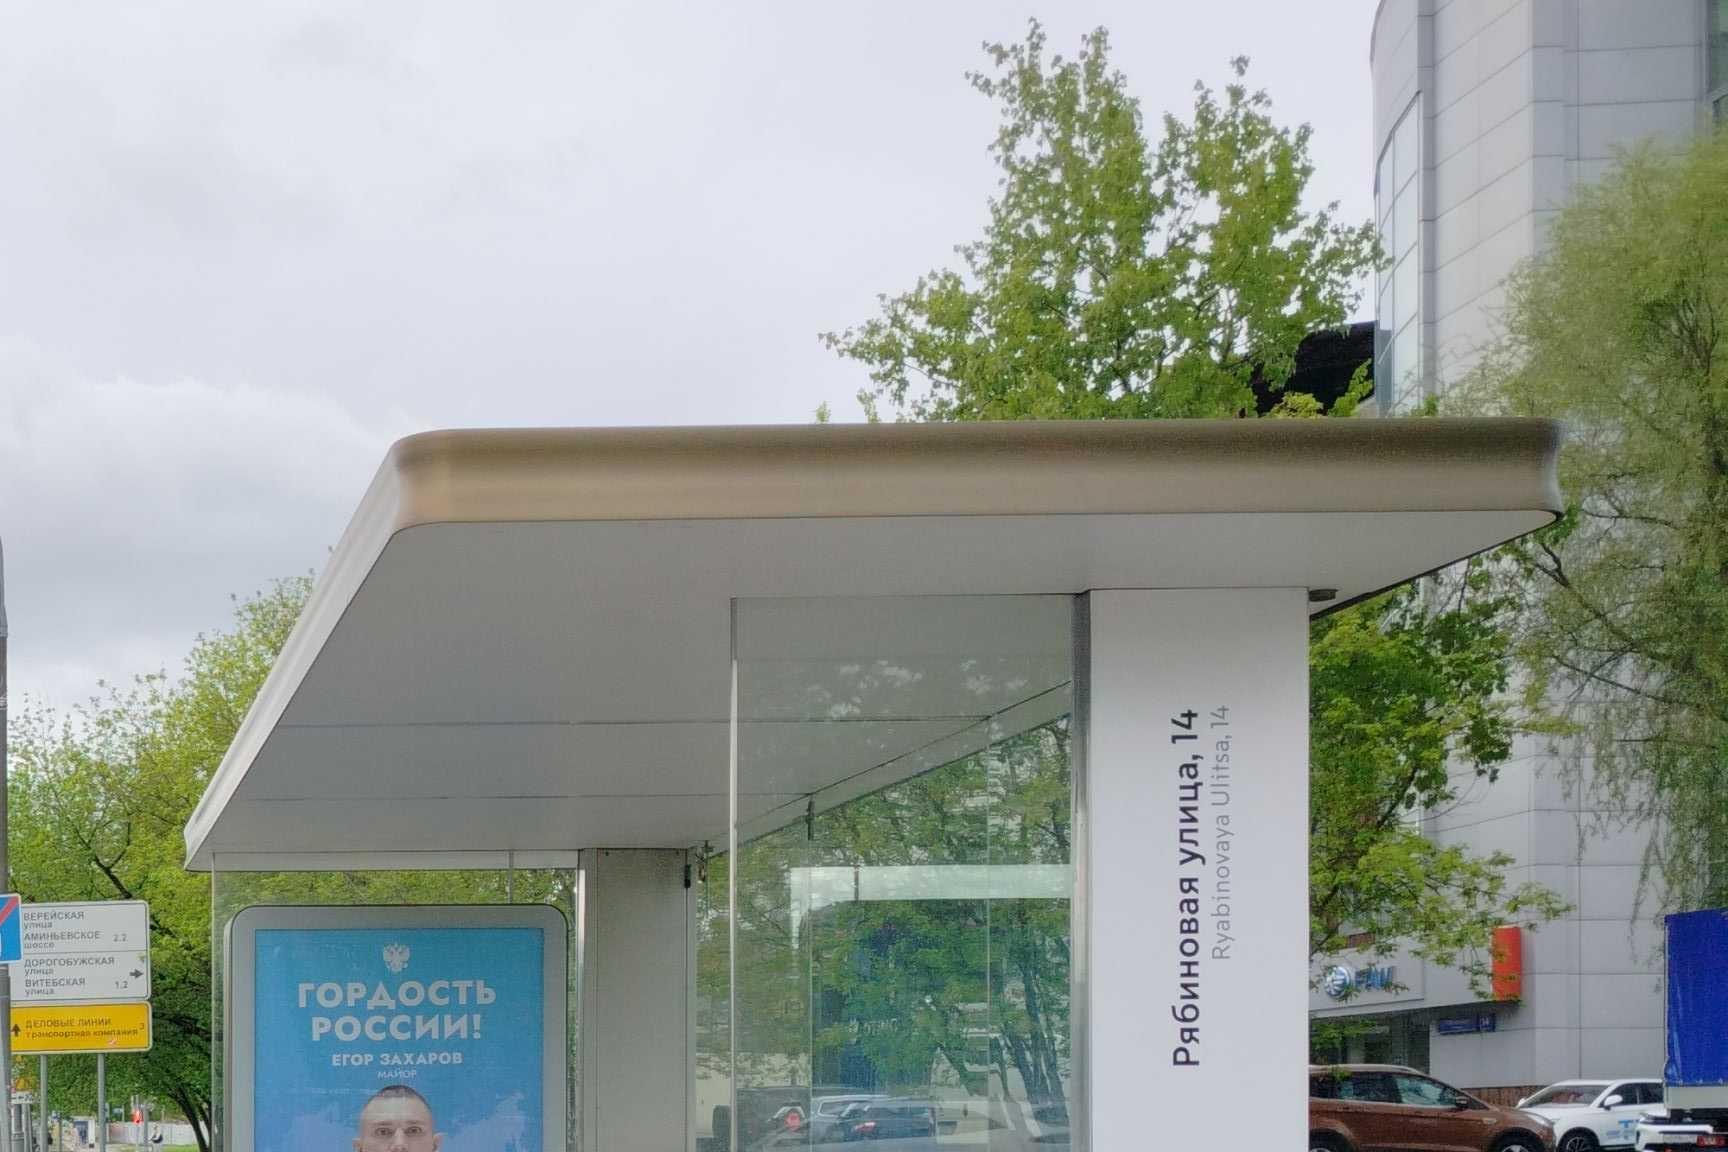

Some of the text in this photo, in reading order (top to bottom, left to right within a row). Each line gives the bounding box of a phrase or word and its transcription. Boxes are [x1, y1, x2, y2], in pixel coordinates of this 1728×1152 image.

[1210, 704, 1236, 960] Ryabinovaya Ulitsa, 14
[1170, 708, 1206, 1066] Рябиновая улица, 14
[23, 910, 85, 921] ВЕРЕЙСКАЯ
[23, 922, 53, 930] улица
[24, 930, 102, 941] АМИНЬЕВСКОЕ
[24, 956, 115, 968] ДОРОГОБУЖСКАЯ
[24, 968, 54, 976] улица
[25, 977, 86, 988] ВИТЕБСКАЯ
[25, 988, 55, 997] улица
[297, 979, 497, 1010] ГОРДОСТЬ
[311, 1013, 482, 1041] РОССИИ!
[331, 1052, 463, 1067] ЕГОР ЗАХАРОВ
[377, 1067, 417, 1080] МАЙОР
